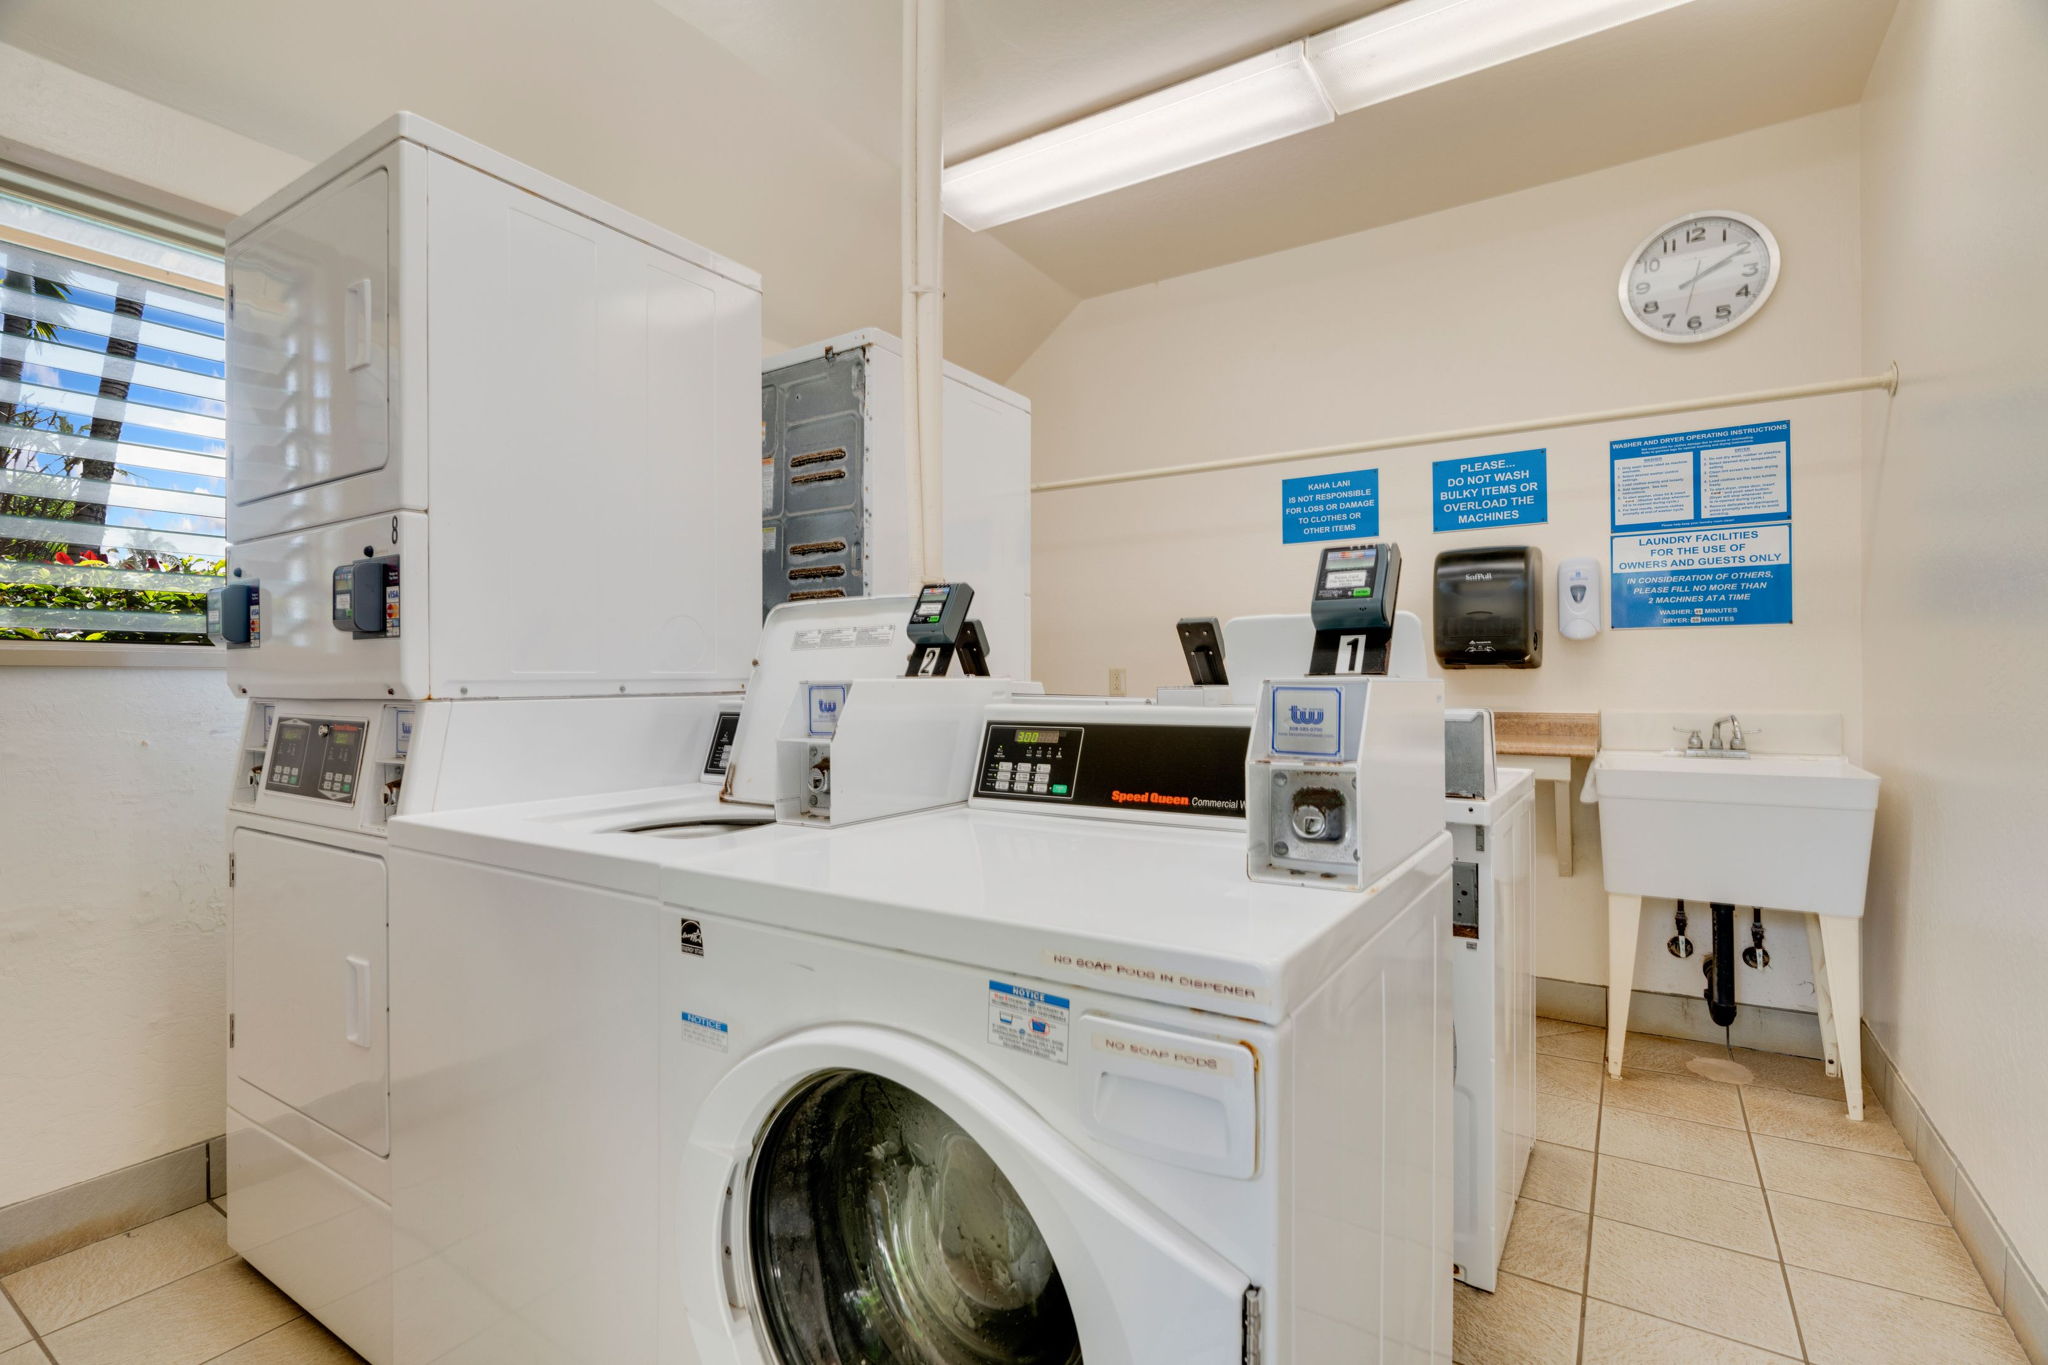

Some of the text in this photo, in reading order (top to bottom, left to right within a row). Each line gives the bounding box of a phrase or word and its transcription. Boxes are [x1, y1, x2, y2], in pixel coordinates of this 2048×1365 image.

[1686, 227, 1706, 243] 12
[1722, 228, 1727, 243] 1
[1663, 238, 1676, 254] 11
[1737, 241, 1751, 255] 2
[1644, 257, 1660, 274] 10
[1741, 262, 1758, 277] 3
[1636, 282, 1651, 295] 9
[1736, 284, 1750, 297] 4
[1643, 301, 1659, 314] 8
[1716, 304, 1731, 319] 5
[1662, 313, 1676, 328] 7
[1687, 315, 1702, 330] 6
[1612, 441, 1642, 449] WASHER
[1660, 436, 1684, 444] DRYER
[1686, 431, 1728, 440] OPERATING
[1730, 424, 1788, 435] INSTRUCTIONS
[1460, 460, 1515, 473] PLEASE...
[1308, 480, 1350, 491] KAHA LANI
[1448, 470, 1529, 487] DO NOT WASH
[1298, 495, 1314, 503] NOT
[1316, 489, 1371, 500] RESPONSIBLE
[1440, 482, 1538, 500] BULKY ITEMS OR
[1286, 507, 1302, 515] FOR
[1304, 505, 1324, 513] LOSS
[1340, 500, 1375, 509] DAMAGE
[1444, 496, 1534, 512] OVERLOAD THE
[1310, 514, 1347, 523] CLOTHES
[1458, 510, 1519, 524] MACHINES
[391, 515, 398, 545] 8
[1303, 524, 1356, 535] OTHER ITEMS
[1639, 531, 1759, 546] LAUNDRY FACILITIES
[1650, 543, 1746, 556] FOR THE USE OF
[1619, 553, 1781, 570] OWNERS AND GUESTS ONLY
[1639, 574, 1713, 584] CONSIDERATION
[1731, 571, 1773, 579] OTHERS,
[388, 590, 399, 599] VISA
[1656, 595, 1704, 603] MACHINES
[920, 650, 936, 674] 2
[1347, 638, 1359, 671] 1
[1112, 790, 1149, 802] Speed
[1150, 792, 1189, 805] Queen
[1192, 797, 1238, 809] Commercial
[1053, 955, 1256, 998] NO SOAP PODS IN DISPENER
[1012, 986, 1045, 1000] NOTICE
[688, 1014, 721, 1029] NOTICE
[1105, 1039, 1217, 1069] NO SOAP PODS
